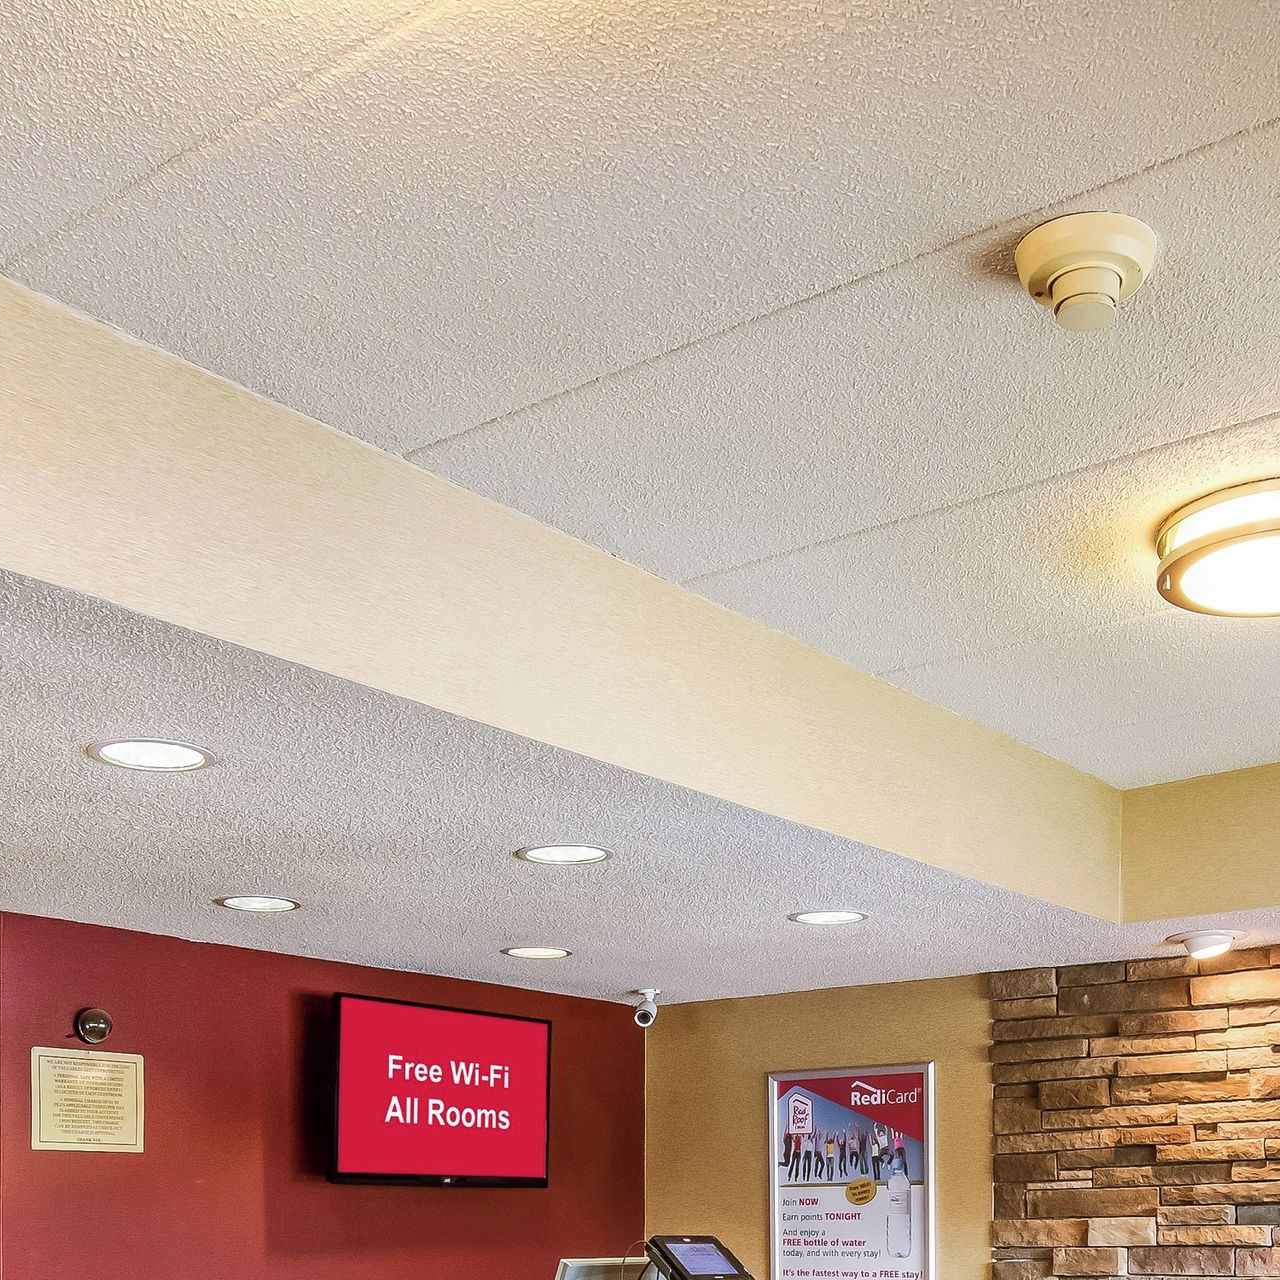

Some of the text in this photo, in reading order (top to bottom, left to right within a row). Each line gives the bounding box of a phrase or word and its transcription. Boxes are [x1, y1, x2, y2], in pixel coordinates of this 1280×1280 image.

[387, 1053, 510, 1089] Free Wi-Fi
[850, 1087, 918, 1106] RediCard
[384, 1095, 510, 1130] All Rooms
[792, 1113, 810, 1126] Roof
[782, 1199, 797, 1207] Join
[782, 1213, 799, 1221] Earn
[800, 1213, 823, 1223] points
[782, 1228, 798, 1237] And
[799, 1229, 820, 1238] enjoy
[782, 1238, 867, 1247] FREE bottle of water
[782, 1249, 805, 1258] today,
[806, 1249, 821, 1257] and
[841, 1251, 861, 1259] every
[863, 1250, 881, 1259] stay!
[782, 1269, 795, 1277] It's
[796, 1269, 810, 1277] the
[812, 1269, 839, 1277] fastest
[841, 1271, 859, 1279] way
[860, 1270, 870, 1278] to
[879, 1270, 900, 1278] FREE
[901, 1270, 923, 1280] stay!
